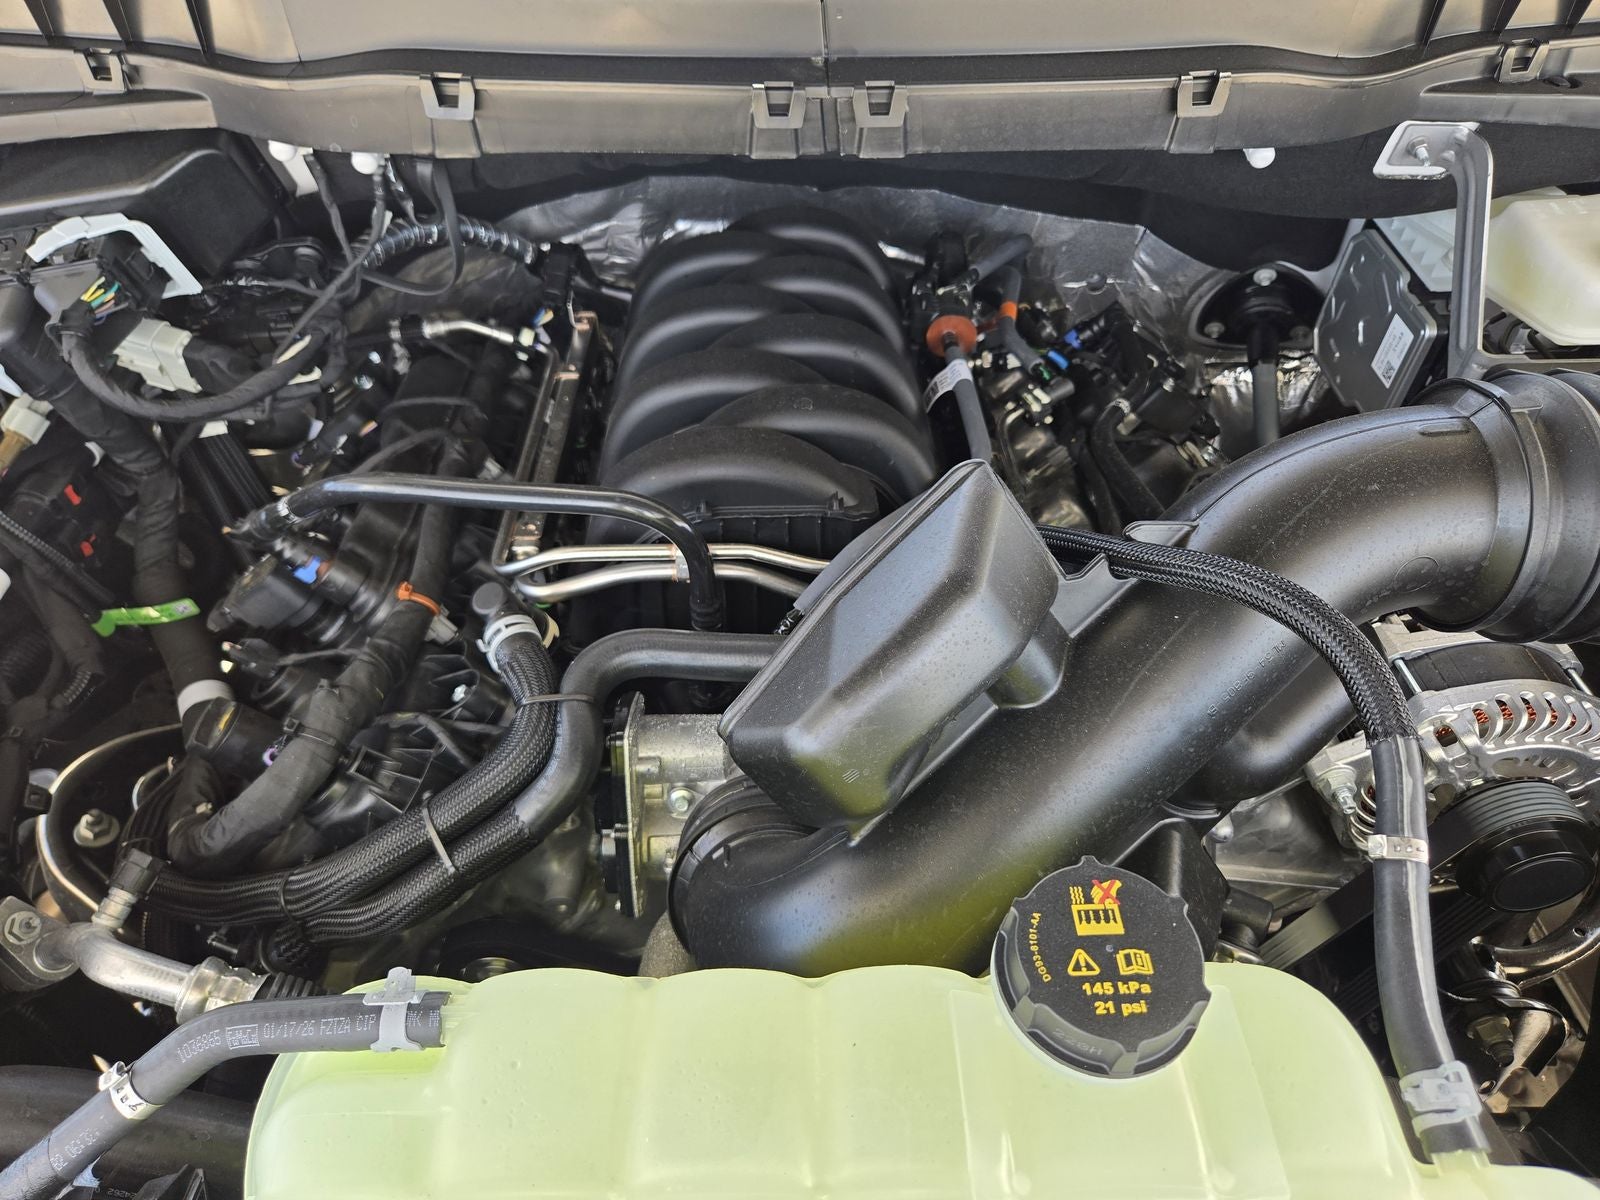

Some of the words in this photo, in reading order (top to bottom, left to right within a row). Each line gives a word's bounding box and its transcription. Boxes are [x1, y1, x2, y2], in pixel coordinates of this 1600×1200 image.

[1082, 982, 1114, 996] 145
[1118, 982, 1152, 995] kPa
[1094, 1001, 1115, 1015] 21
[1121, 1000, 1148, 1017] psi
[263, 1019, 315, 1039] 01/17/26
